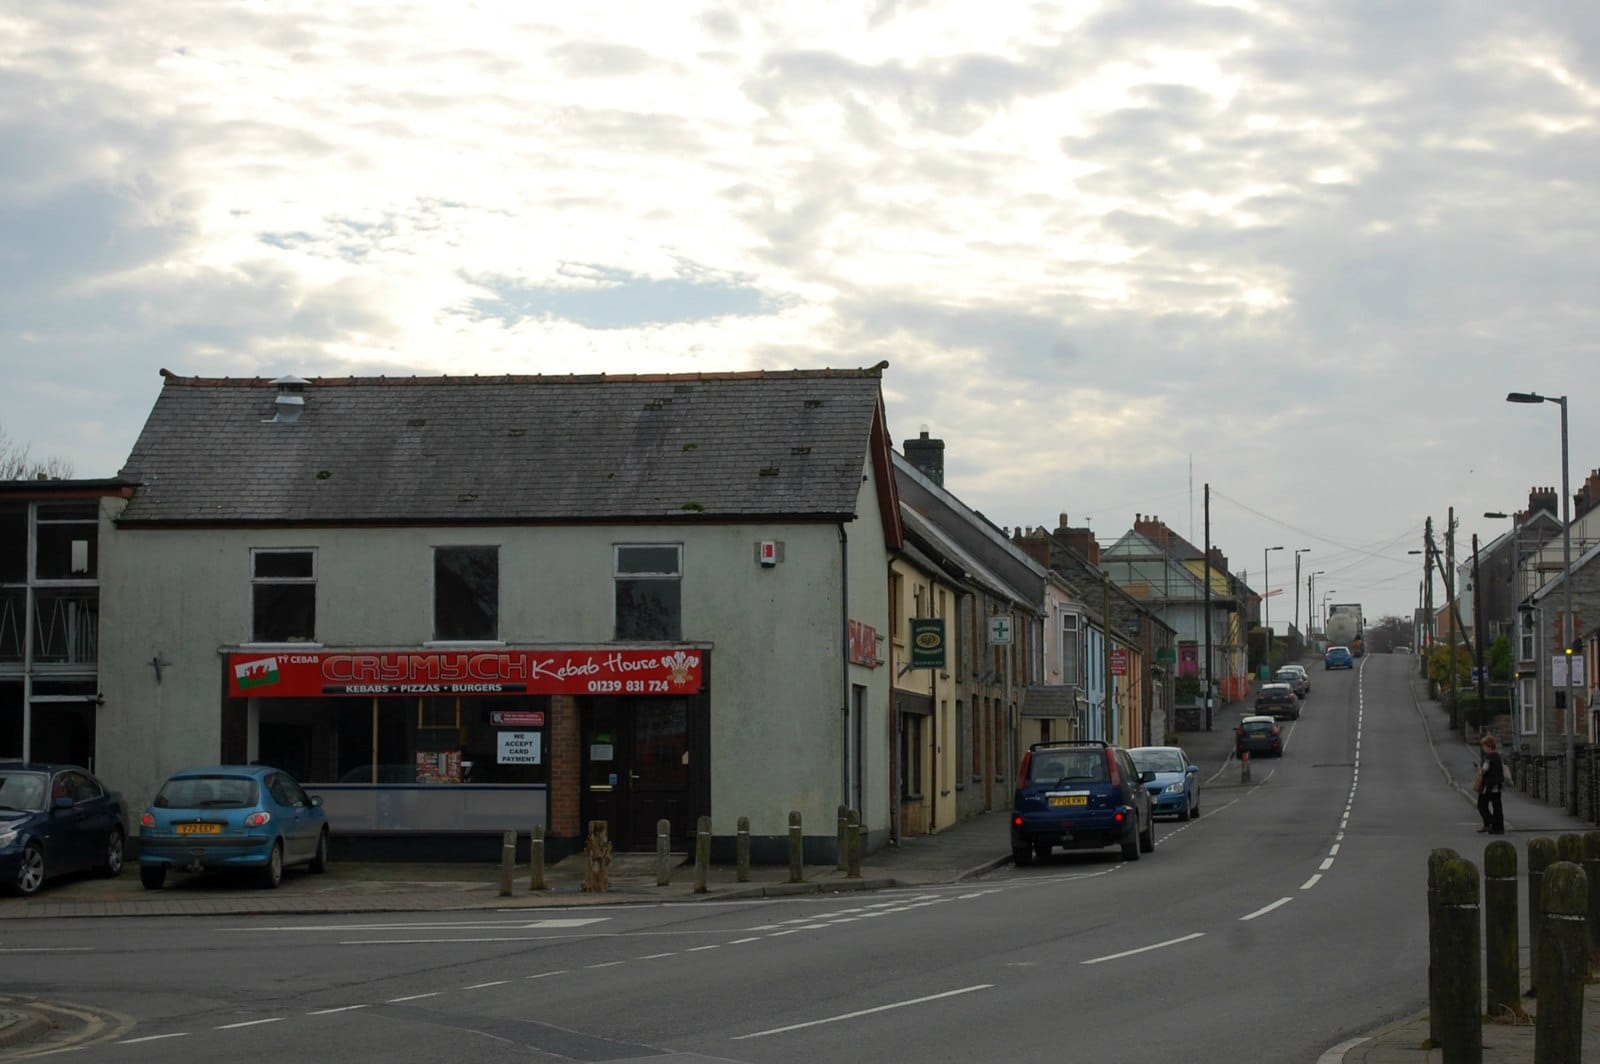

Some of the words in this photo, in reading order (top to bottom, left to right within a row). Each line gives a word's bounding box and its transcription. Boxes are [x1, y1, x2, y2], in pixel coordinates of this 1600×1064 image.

[290, 655, 319, 664] CEBAB
[321, 653, 528, 681] CRYMYCH
[532, 656, 600, 681] Kebab
[602, 651, 660, 674] House
[345, 684, 389, 693] KEBABS
[400, 683, 441, 693] PIZZAS
[452, 683, 503, 692] BURGERS
[587, 680, 622, 692] 01239
[626, 680, 645, 692] 831
[648, 680, 670, 692] 724
